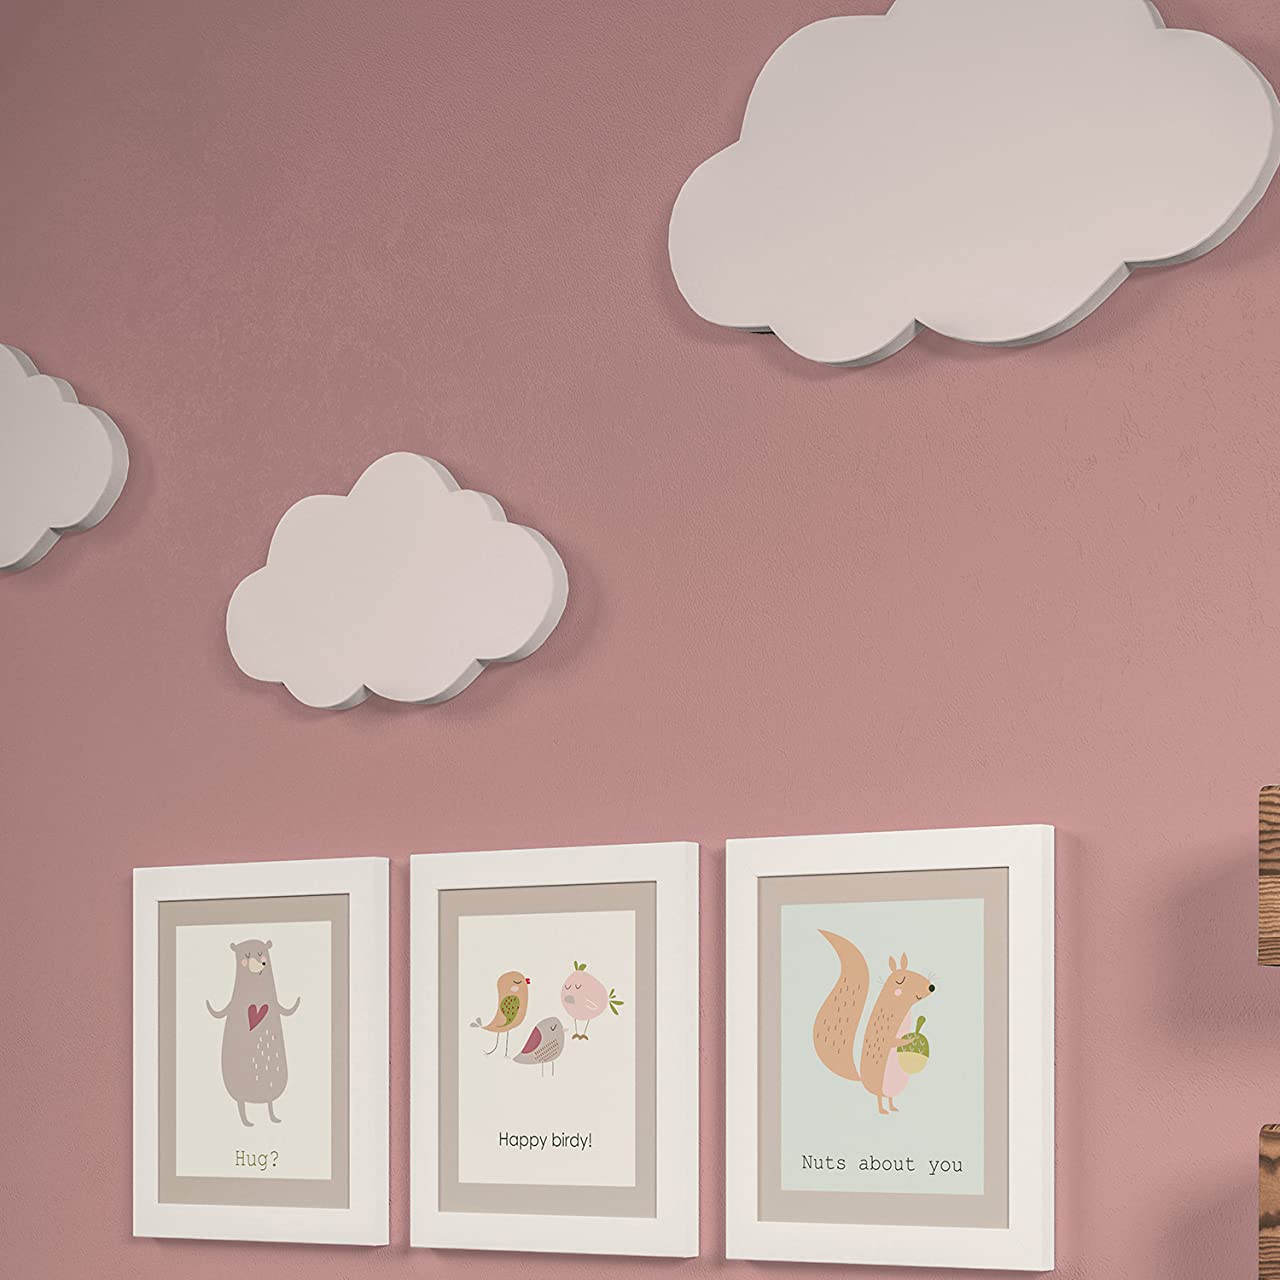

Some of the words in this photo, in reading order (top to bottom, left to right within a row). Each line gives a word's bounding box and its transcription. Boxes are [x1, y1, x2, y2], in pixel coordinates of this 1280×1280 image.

[499, 1132, 548, 1150] Happy
[551, 1132, 592, 1151] birdy!
[235, 1150, 279, 1171] Hug?
[801, 1155, 846, 1170] Nuts
[858, 1156, 916, 1172] about
[928, 1159, 963, 1175] you
